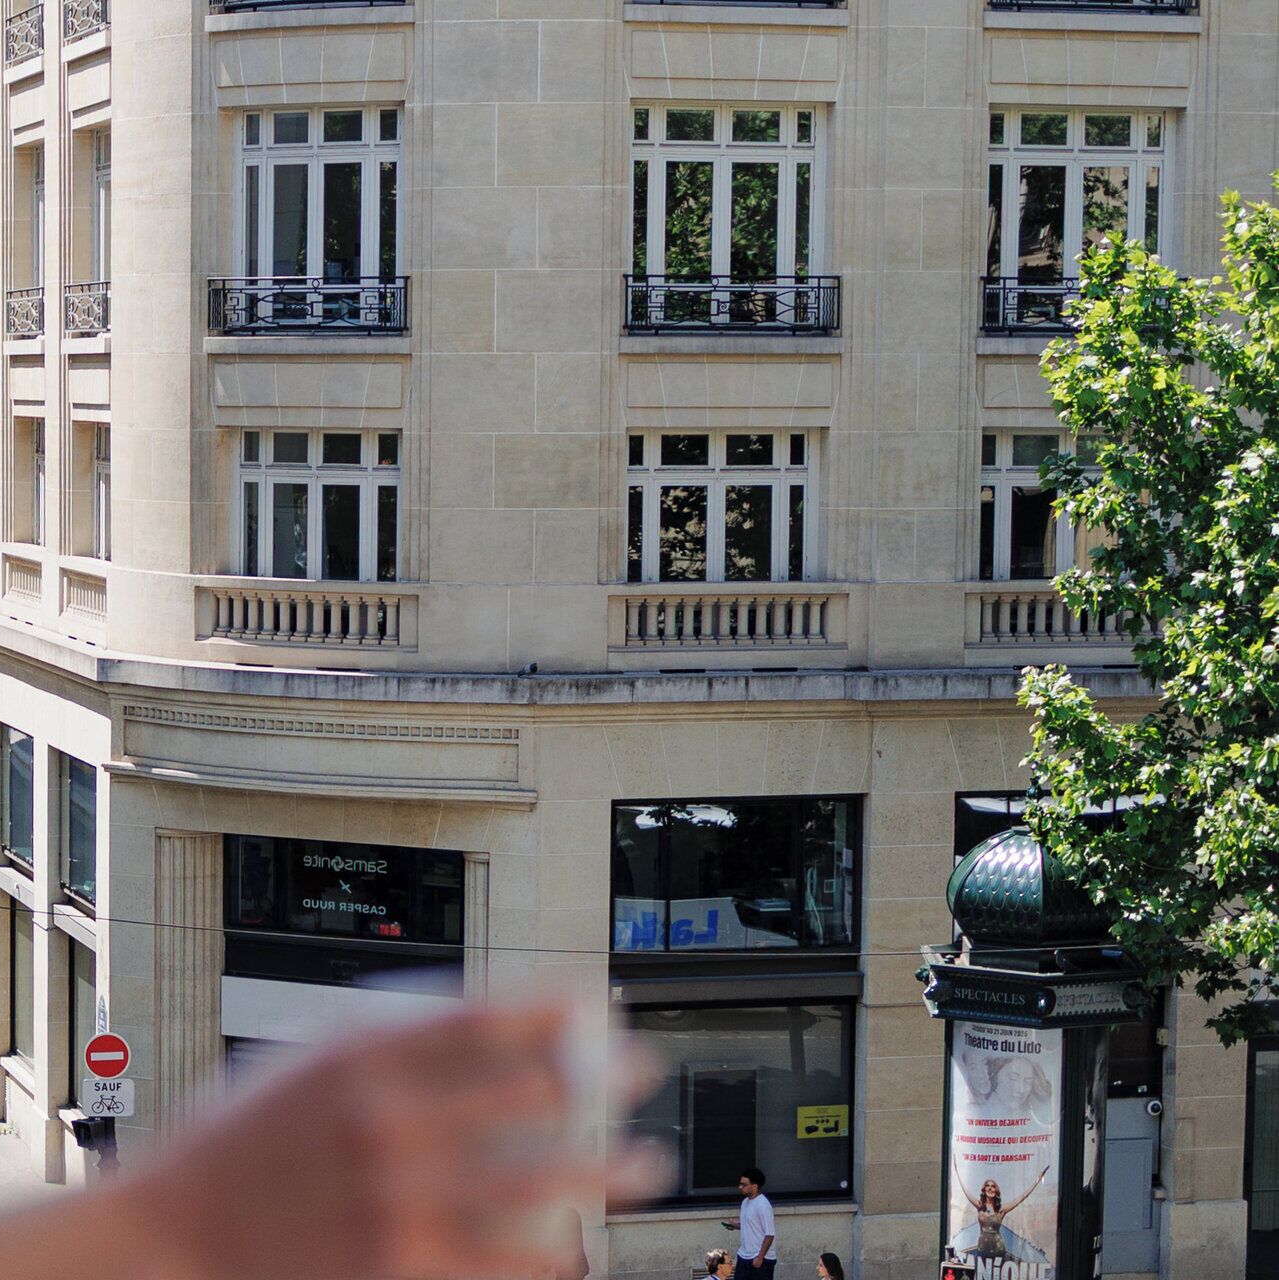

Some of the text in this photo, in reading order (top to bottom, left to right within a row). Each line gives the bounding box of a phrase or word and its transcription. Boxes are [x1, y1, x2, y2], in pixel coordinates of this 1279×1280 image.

[954, 988, 1026, 1005] SPECTACLES
[1057, 992, 1120, 1008] SPECTACLES
[1001, 1039, 1015, 1052] du
[1018, 1041, 1042, 1054] Lido
[94, 1082, 122, 1092] SAUF
[977, 1136, 1006, 1145] MUSICALE
[1008, 1136, 1019, 1144] QUI
